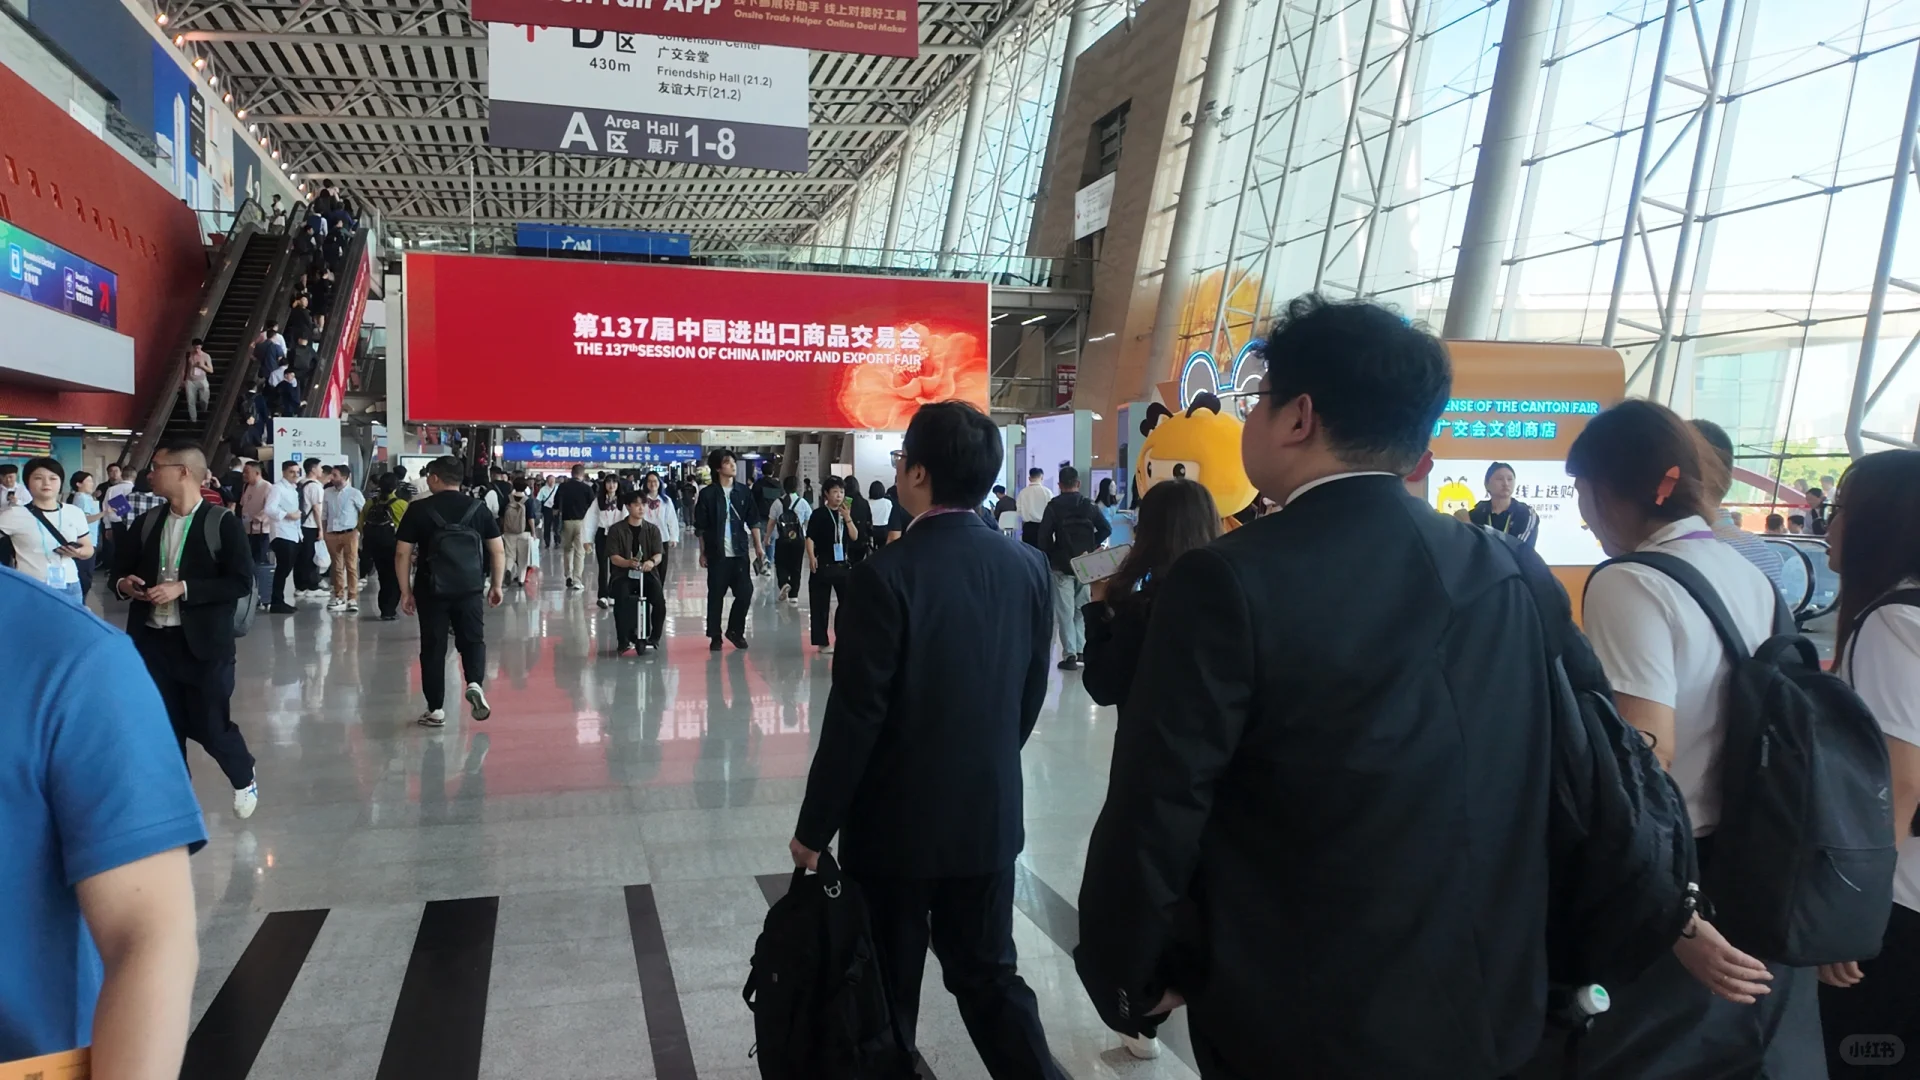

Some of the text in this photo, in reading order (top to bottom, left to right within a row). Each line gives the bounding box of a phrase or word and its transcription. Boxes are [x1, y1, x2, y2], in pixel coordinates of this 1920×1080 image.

[662, 0, 722, 15] APP
[824, 3, 907, 22] 线上对接好工具
[734, 9, 908, 34] Onsite Trade Helper Online Deal Maker
[616, 32, 637, 54] 区
[589, 57, 632, 73] 430m
[657, 46, 710, 64] 广交会堂
[657, 66, 773, 88] Friendship Hall (21.2)
[559, 111, 599, 151] A
[604, 114, 680, 137] Area Hall
[606, 129, 680, 156] 区 展厅
[685, 124, 736, 160] 1-8
[573, 312, 921, 350] 第137届中国进出口商品交易会
[574, 341, 603, 355] THE
[698, 347, 717, 359] OF
[718, 347, 760, 361] CHINA
[762, 349, 812, 363] IMPORT
[813, 350, 841, 364] AND
[843, 352, 891, 365] EXPORT
[894, 353, 922, 366] FAIR
[1476, 400, 1493, 412] OF
[1495, 400, 1518, 413] THE
[1520, 400, 1570, 414] CANTON
[1572, 401, 1599, 414] FAIR
[1435, 419, 1556, 438] 广交会文创商店
[546, 446, 592, 458] 中国信保
[1515, 484, 1574, 498] 线上选购
